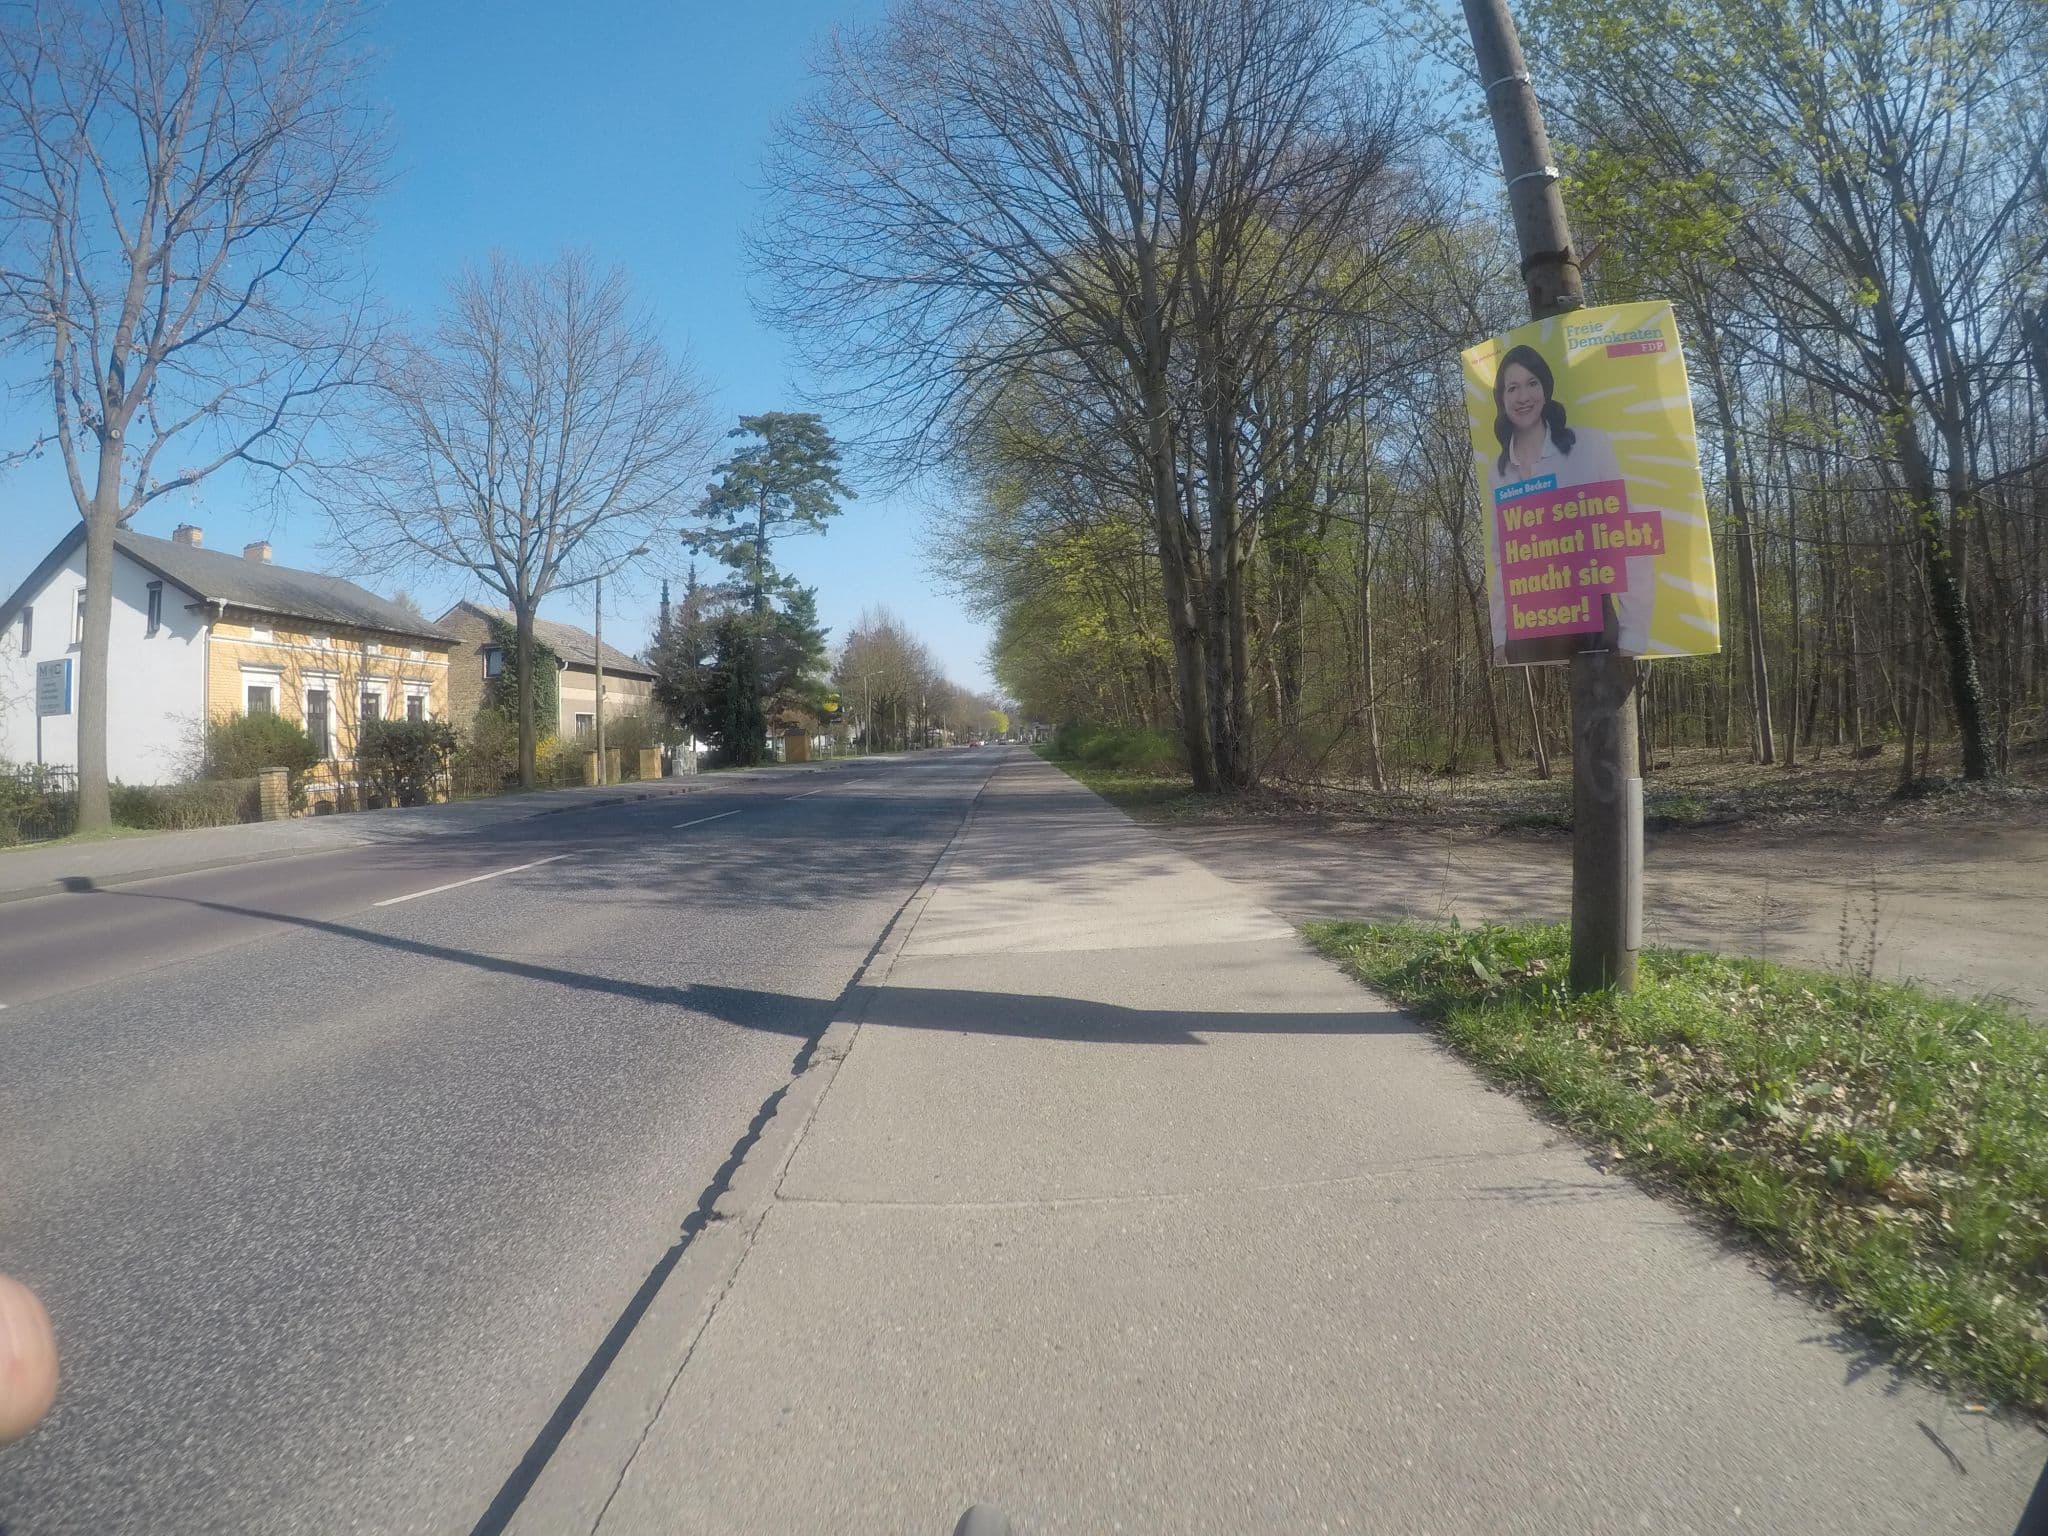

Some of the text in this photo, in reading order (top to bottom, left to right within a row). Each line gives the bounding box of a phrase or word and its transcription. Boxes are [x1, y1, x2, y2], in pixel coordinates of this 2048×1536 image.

[1566, 322, 1604, 337] Freie
[1567, 328, 1664, 351] Demokraten
[1641, 342, 1664, 352] FDP
[1499, 486, 1524, 500] Sabine
[1503, 491, 1620, 532] Wer seine
[1505, 520, 1660, 564] Heimat liebt,
[1509, 558, 1617, 597] macht sie
[1512, 596, 1590, 630] besser!
